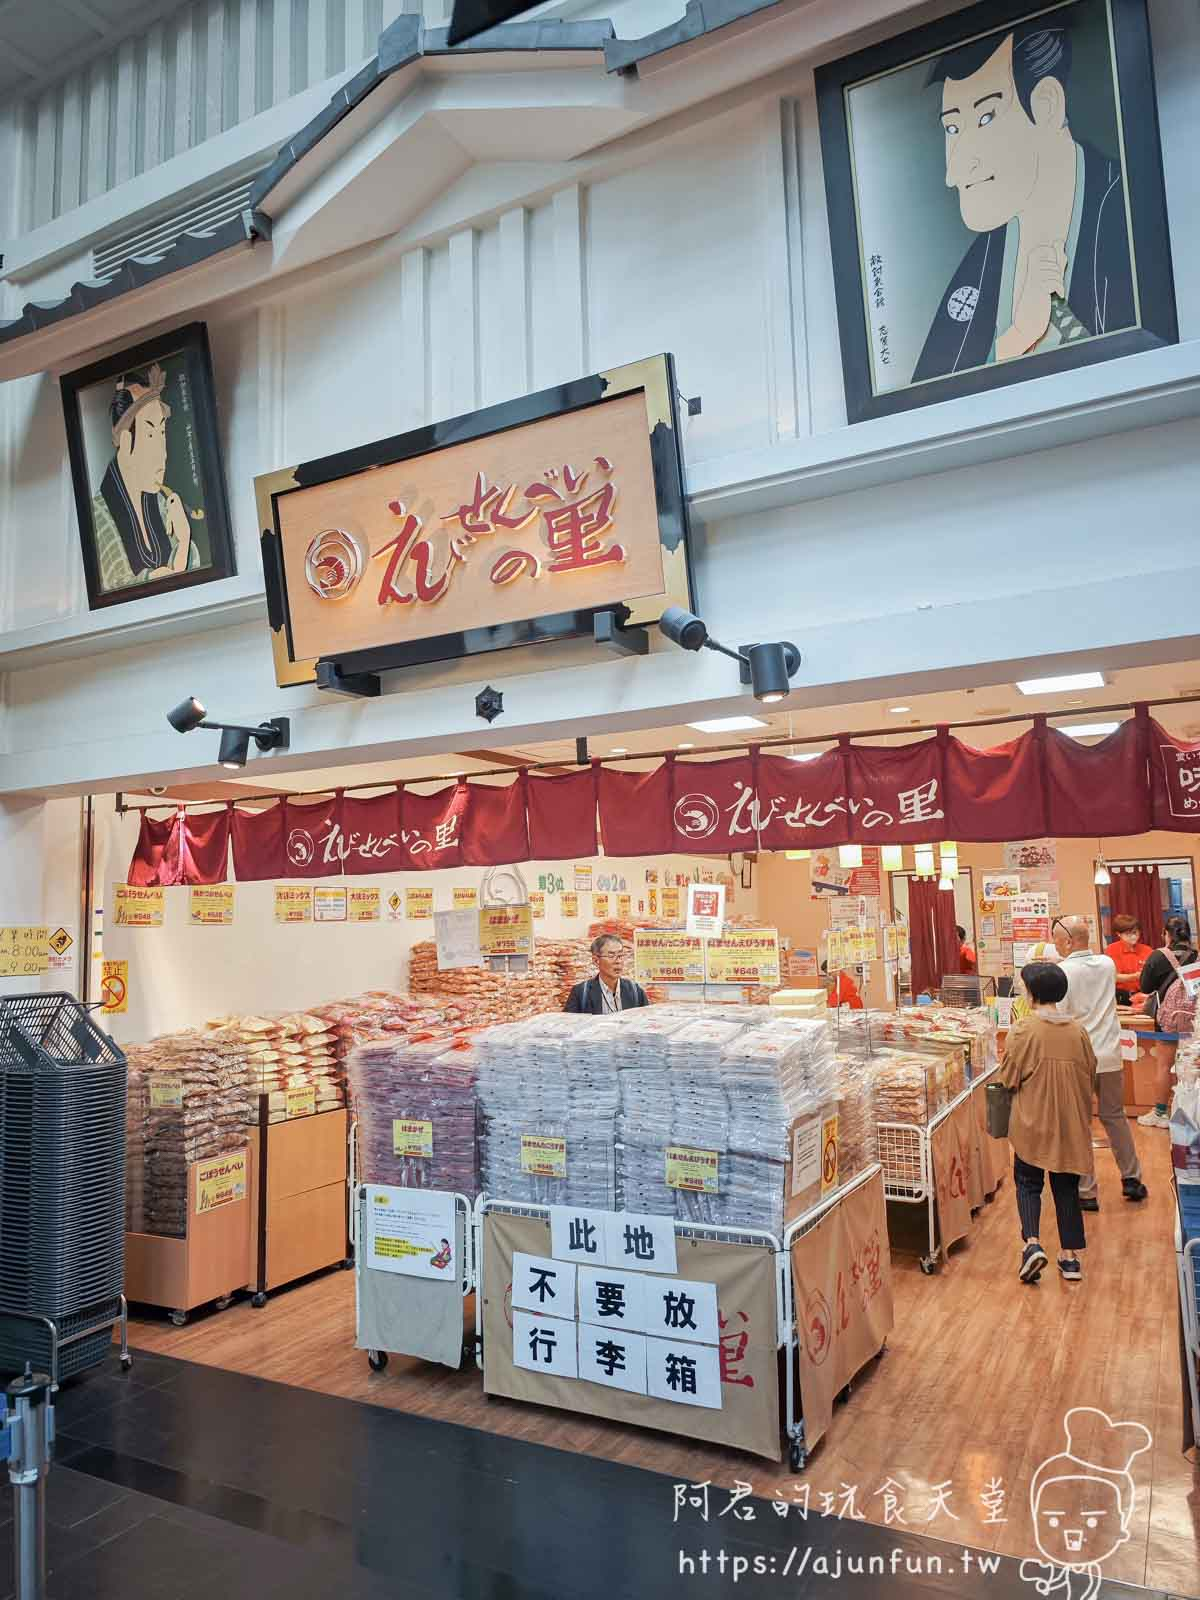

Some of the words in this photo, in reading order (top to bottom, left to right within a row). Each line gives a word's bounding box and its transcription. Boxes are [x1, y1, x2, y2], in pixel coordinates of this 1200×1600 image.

[371, 455, 627, 607] えびせんべいの里
[725, 778, 945, 837] えびせんべいの里
[318, 814, 461, 865] えびせんべいの里
[733, 967, 759, 975] ¥648
[200, 1162, 244, 1181] ごぼうせんべい
[568, 1217, 656, 1262] 此地
[528, 1267, 697, 1331] 不要放
[528, 1327, 697, 1395] 行李箱
